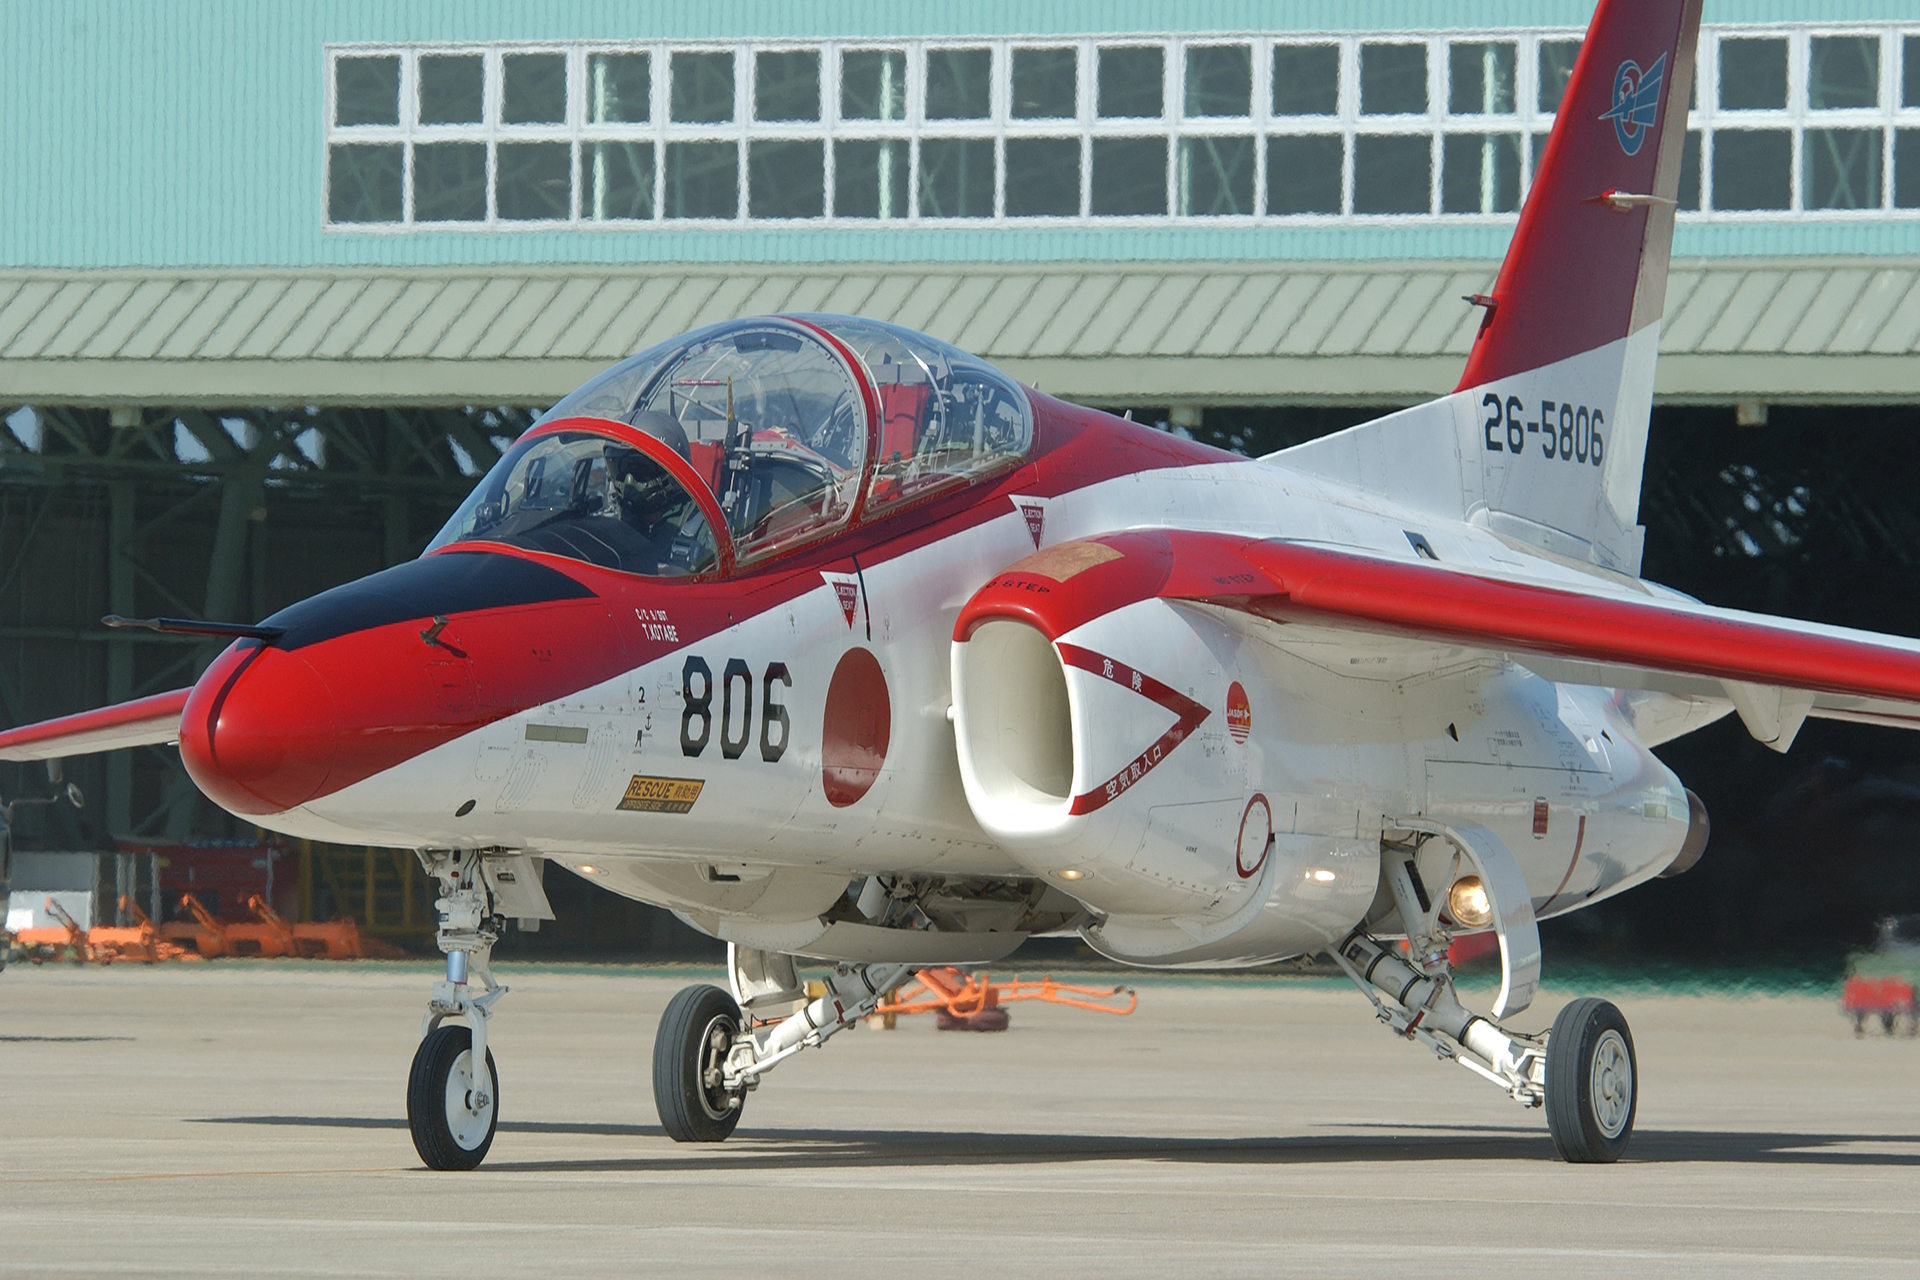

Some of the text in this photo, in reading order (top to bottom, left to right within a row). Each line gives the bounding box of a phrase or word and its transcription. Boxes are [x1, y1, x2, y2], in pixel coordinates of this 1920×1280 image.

[1482, 393, 1604, 467] 26-5806
[1024, 509, 1043, 519] EJECTION
[1030, 523, 1041, 533] SEAT
[836, 586, 857, 597] EJECTION
[1002, 580, 1050, 593] STEP
[842, 600, 854, 610] SEAT
[1102, 658, 1143, 692] 危険
[638, 686, 646, 703] 2
[680, 655, 792, 763] 806
[1227, 708, 1243, 718] JASDF
[1105, 744, 1162, 801] 空気取入口
[626, 780, 674, 799] RESCUE
